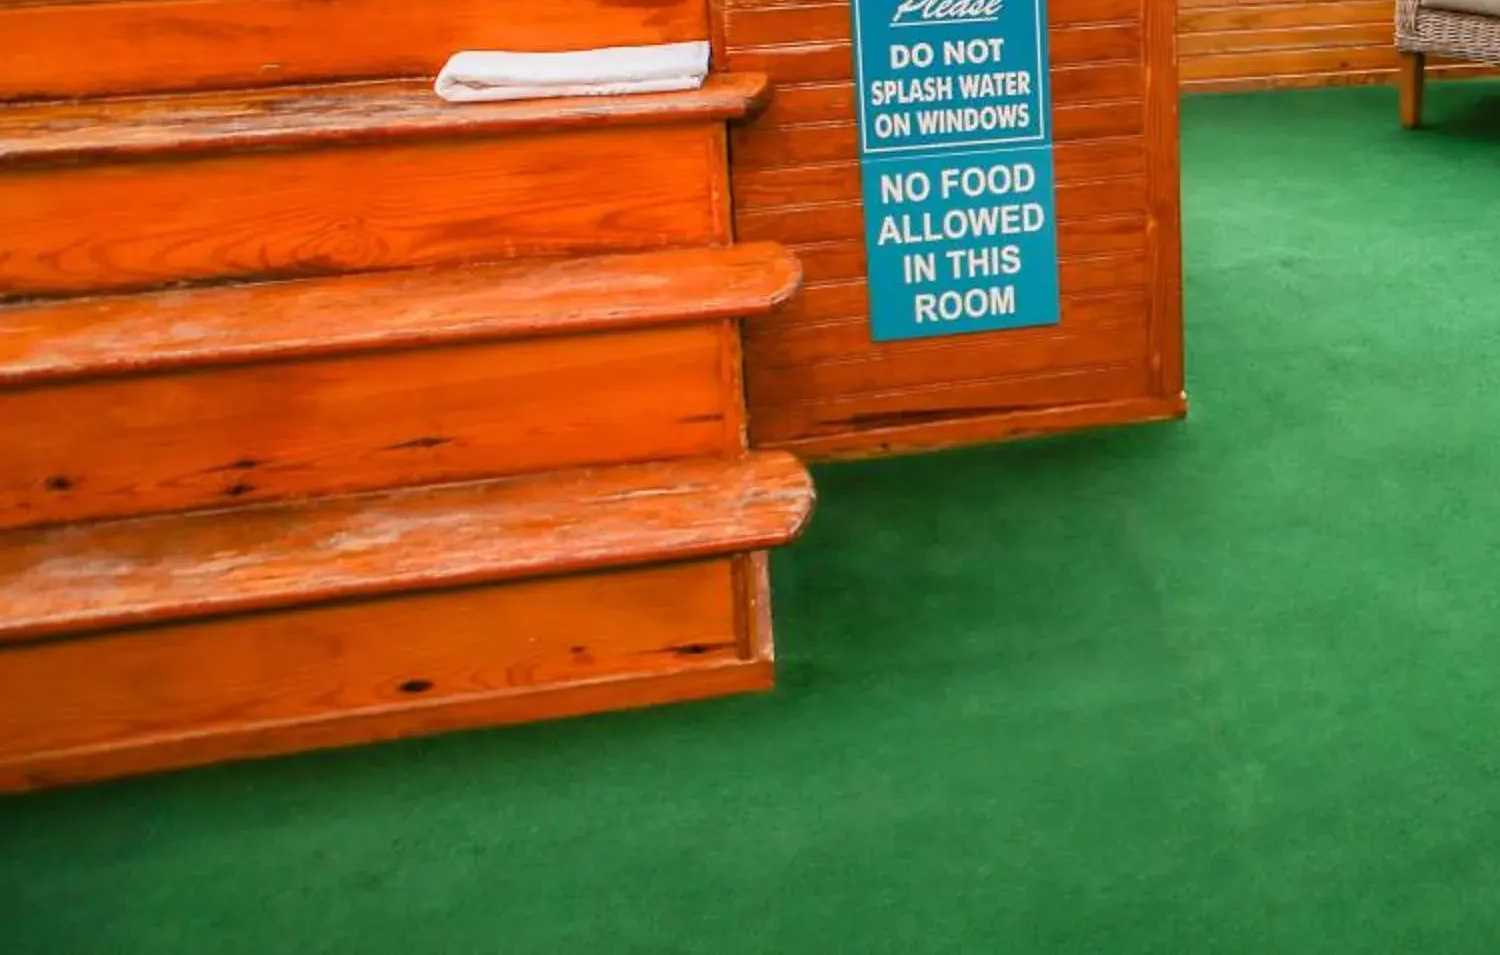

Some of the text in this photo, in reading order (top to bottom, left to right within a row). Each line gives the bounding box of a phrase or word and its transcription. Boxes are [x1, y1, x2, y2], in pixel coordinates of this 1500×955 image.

[890, 38, 1004, 69] DO NOT
[871, 71, 1030, 106] SPLASH WATER
[874, 104, 1030, 138] ON WINDOWS
[881, 163, 1035, 204] NO FOOD
[878, 202, 1045, 246] ALLOWED
[903, 244, 1021, 284] IN THIS
[915, 286, 1015, 323] ROOM
